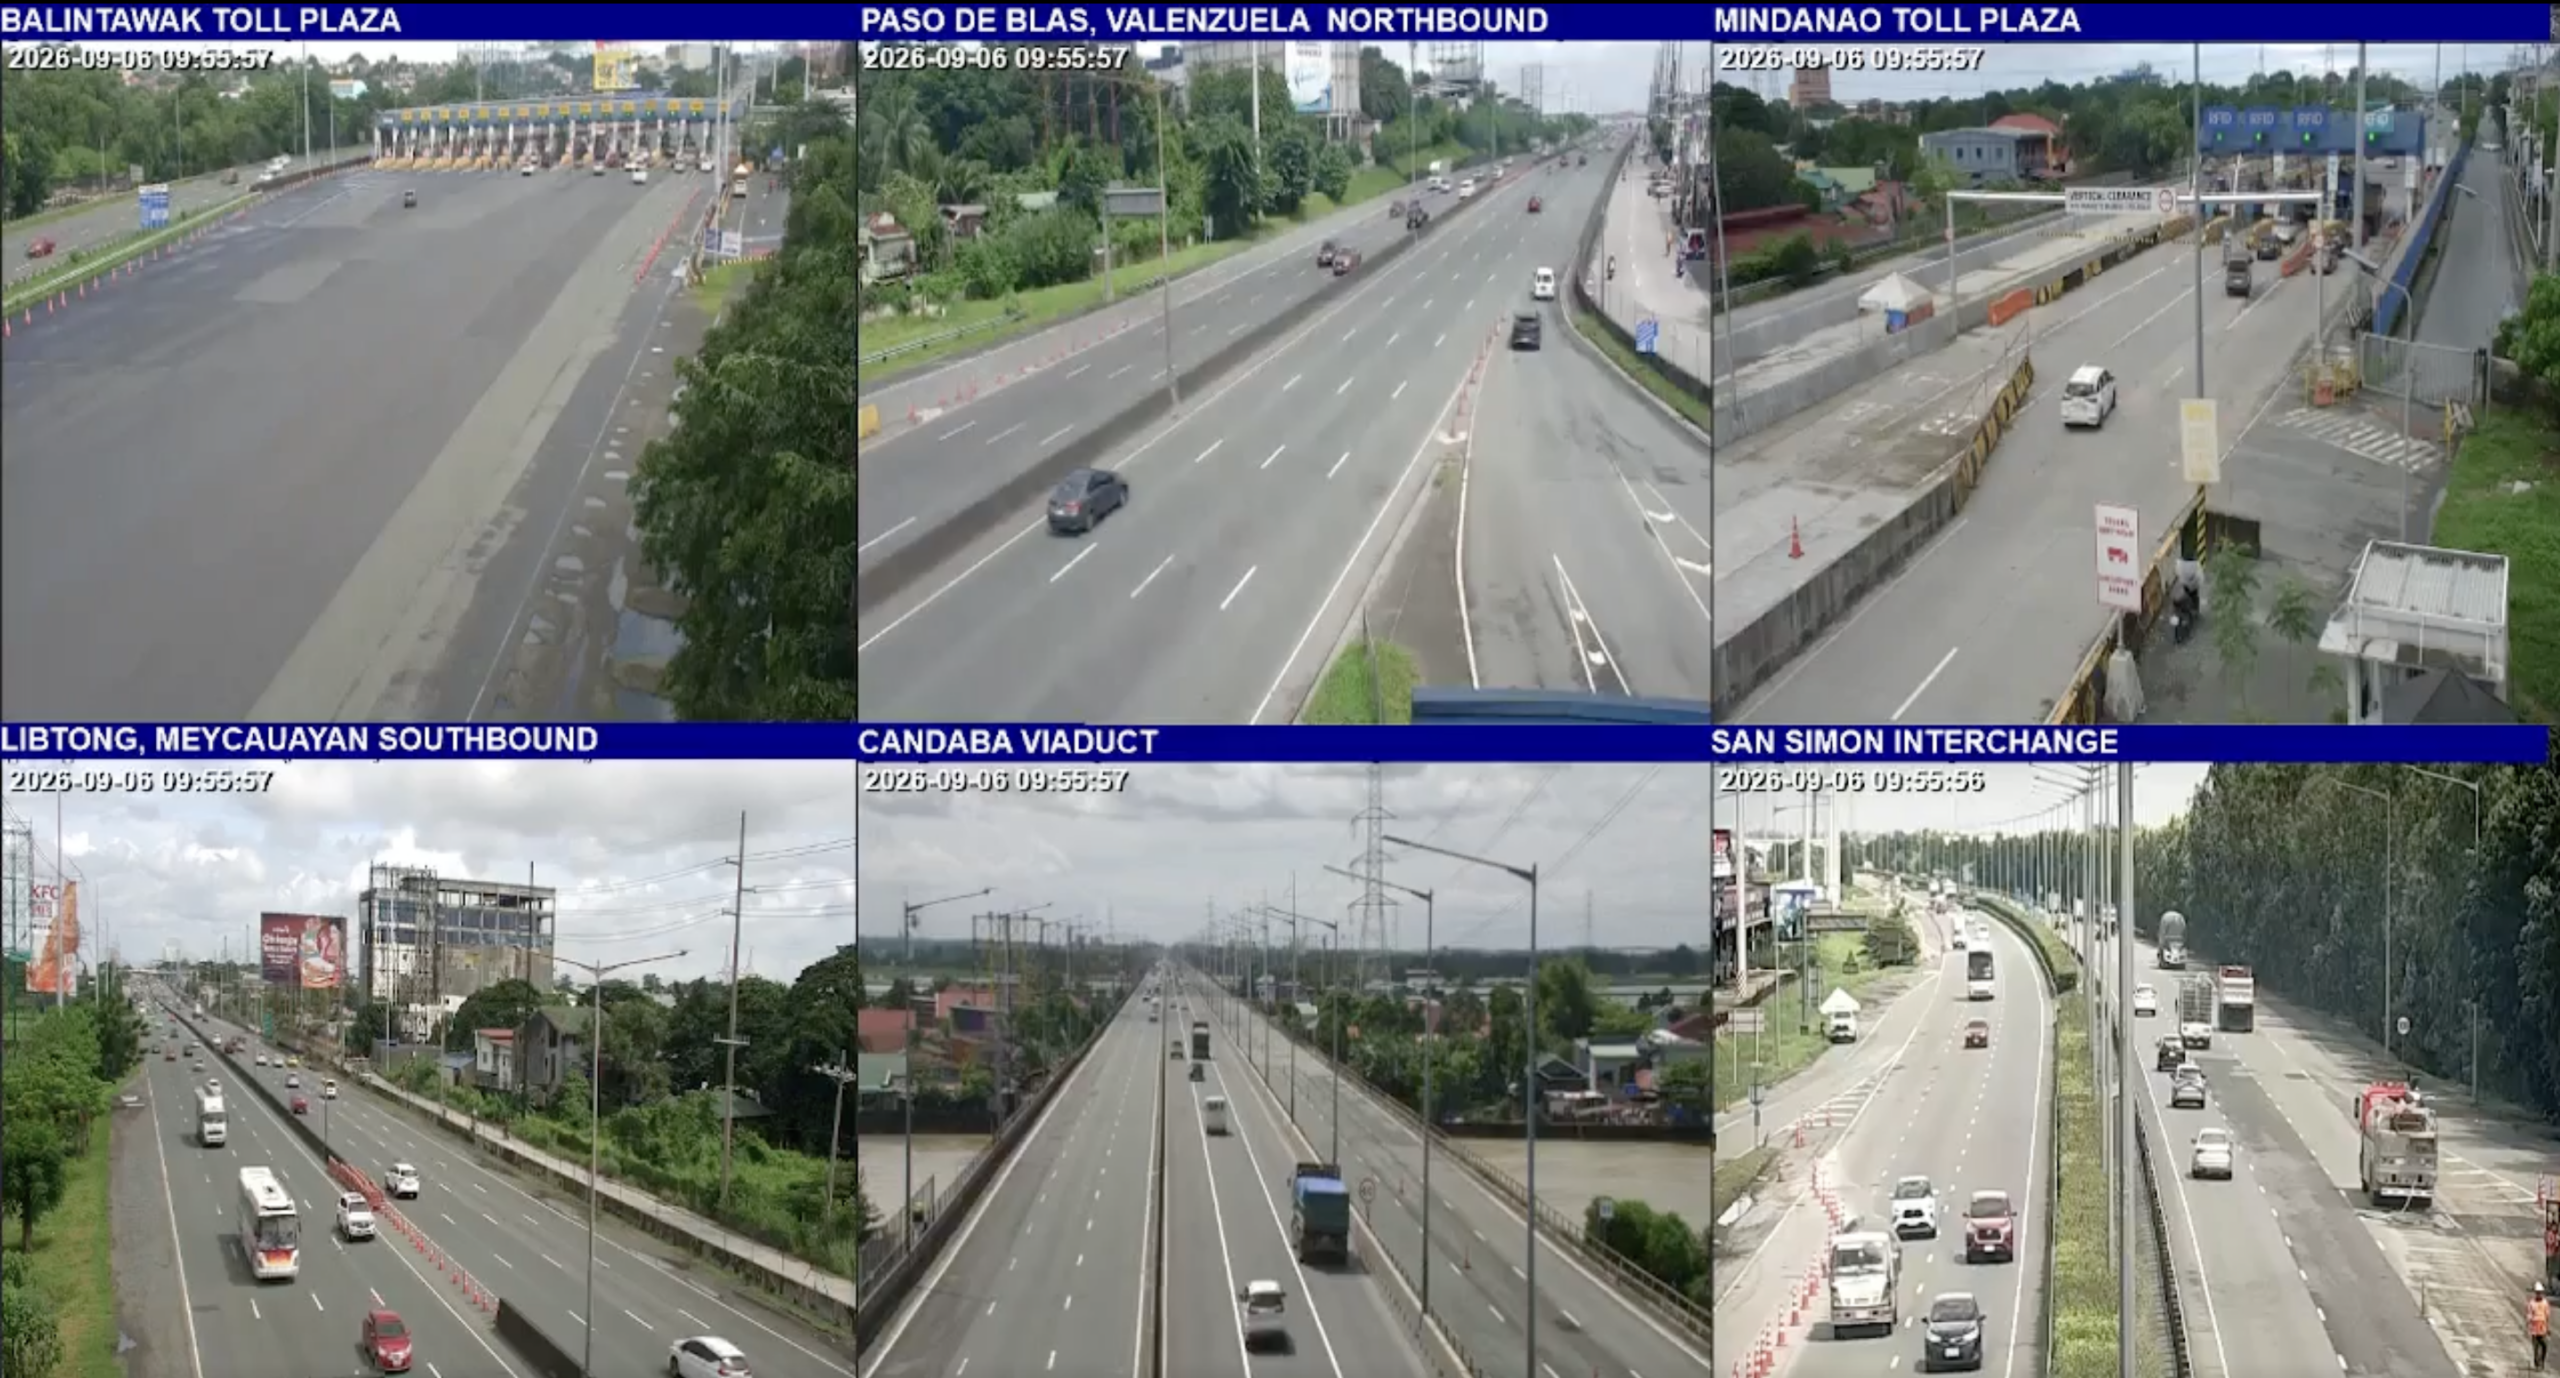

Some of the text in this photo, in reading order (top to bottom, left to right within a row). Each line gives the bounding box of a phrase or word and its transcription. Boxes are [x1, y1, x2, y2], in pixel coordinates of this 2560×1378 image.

[2208, 112, 2232, 124] RFID
[2249, 113, 2274, 125] RFID
[2297, 113, 2323, 126] RFID
[2107, 191, 2152, 201] CLEARANCE
[31, 885, 60, 900] KFC
